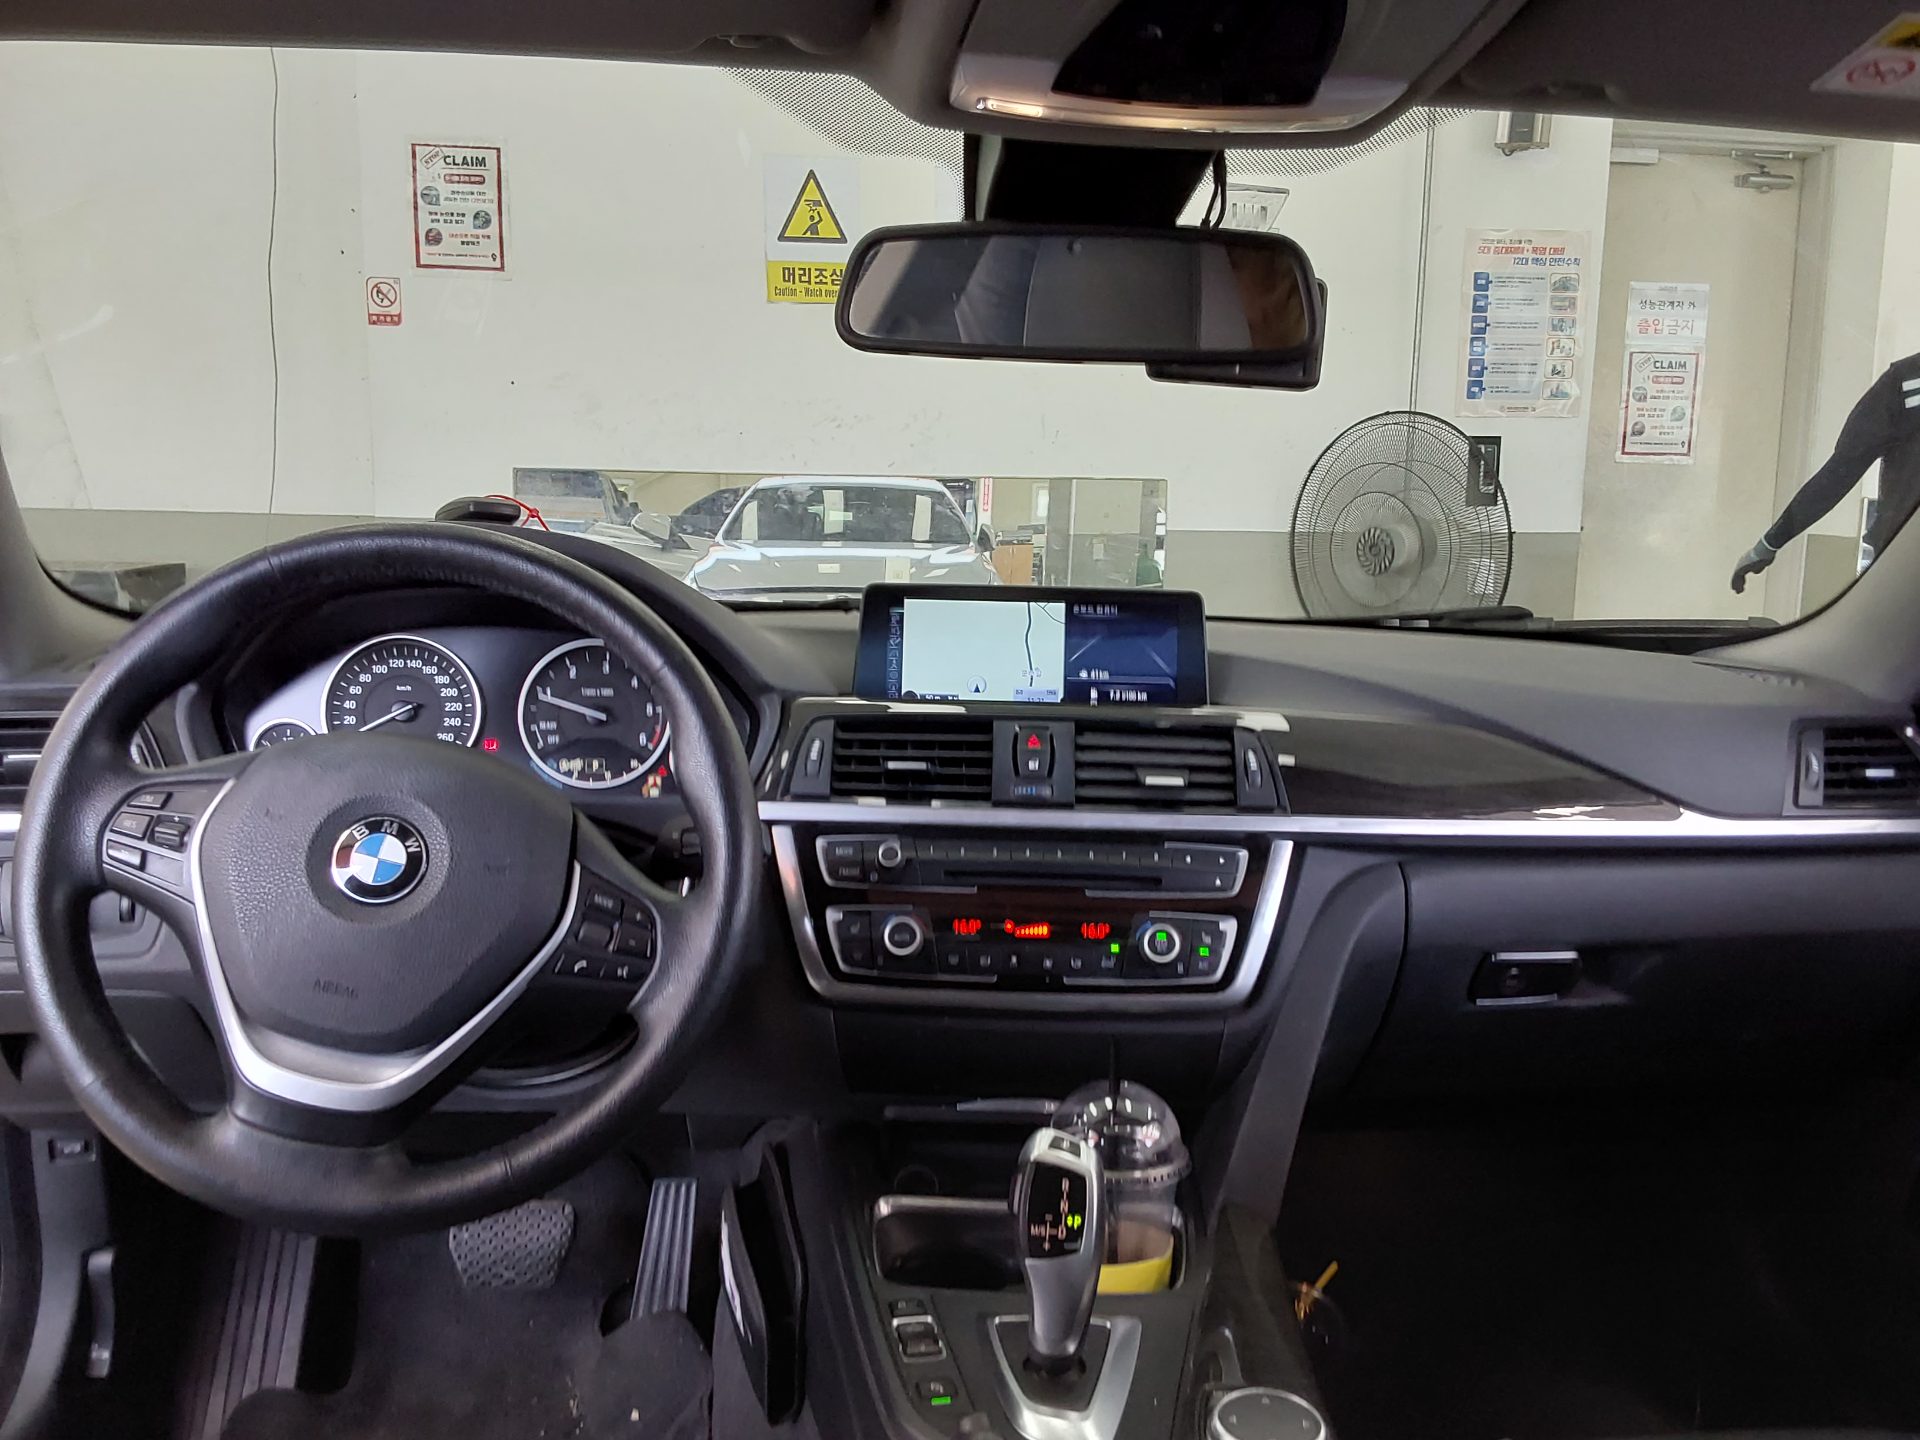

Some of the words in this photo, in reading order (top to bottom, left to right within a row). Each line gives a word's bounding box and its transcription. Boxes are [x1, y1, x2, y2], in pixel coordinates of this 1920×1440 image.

[443, 155, 487, 168] CLAIM
[782, 267, 843, 285] 머리조심
[774, 286, 798, 297] Caution
[804, 287, 823, 298] Watch
[1639, 299, 1684, 310] 성능관계자
[1637, 317, 1694, 335] 출입금지
[1653, 360, 1687, 370] CLAIM
[388, 659, 404, 668] 120
[406, 660, 422, 668] 140
[372, 665, 388, 674] 100
[422, 666, 437, 675] 160
[360, 674, 371, 683] 80
[434, 676, 450, 684] 180
[350, 686, 362, 695] 60
[440, 688, 458, 697] 200
[344, 701, 356, 709] 40
[445, 703, 462, 712] 220
[344, 716, 356, 725] 20
[444, 718, 461, 727] 240
[437, 733, 454, 742] 260
[351, 820, 421, 853] BMW
[1061, 1199, 1069, 1214] N
